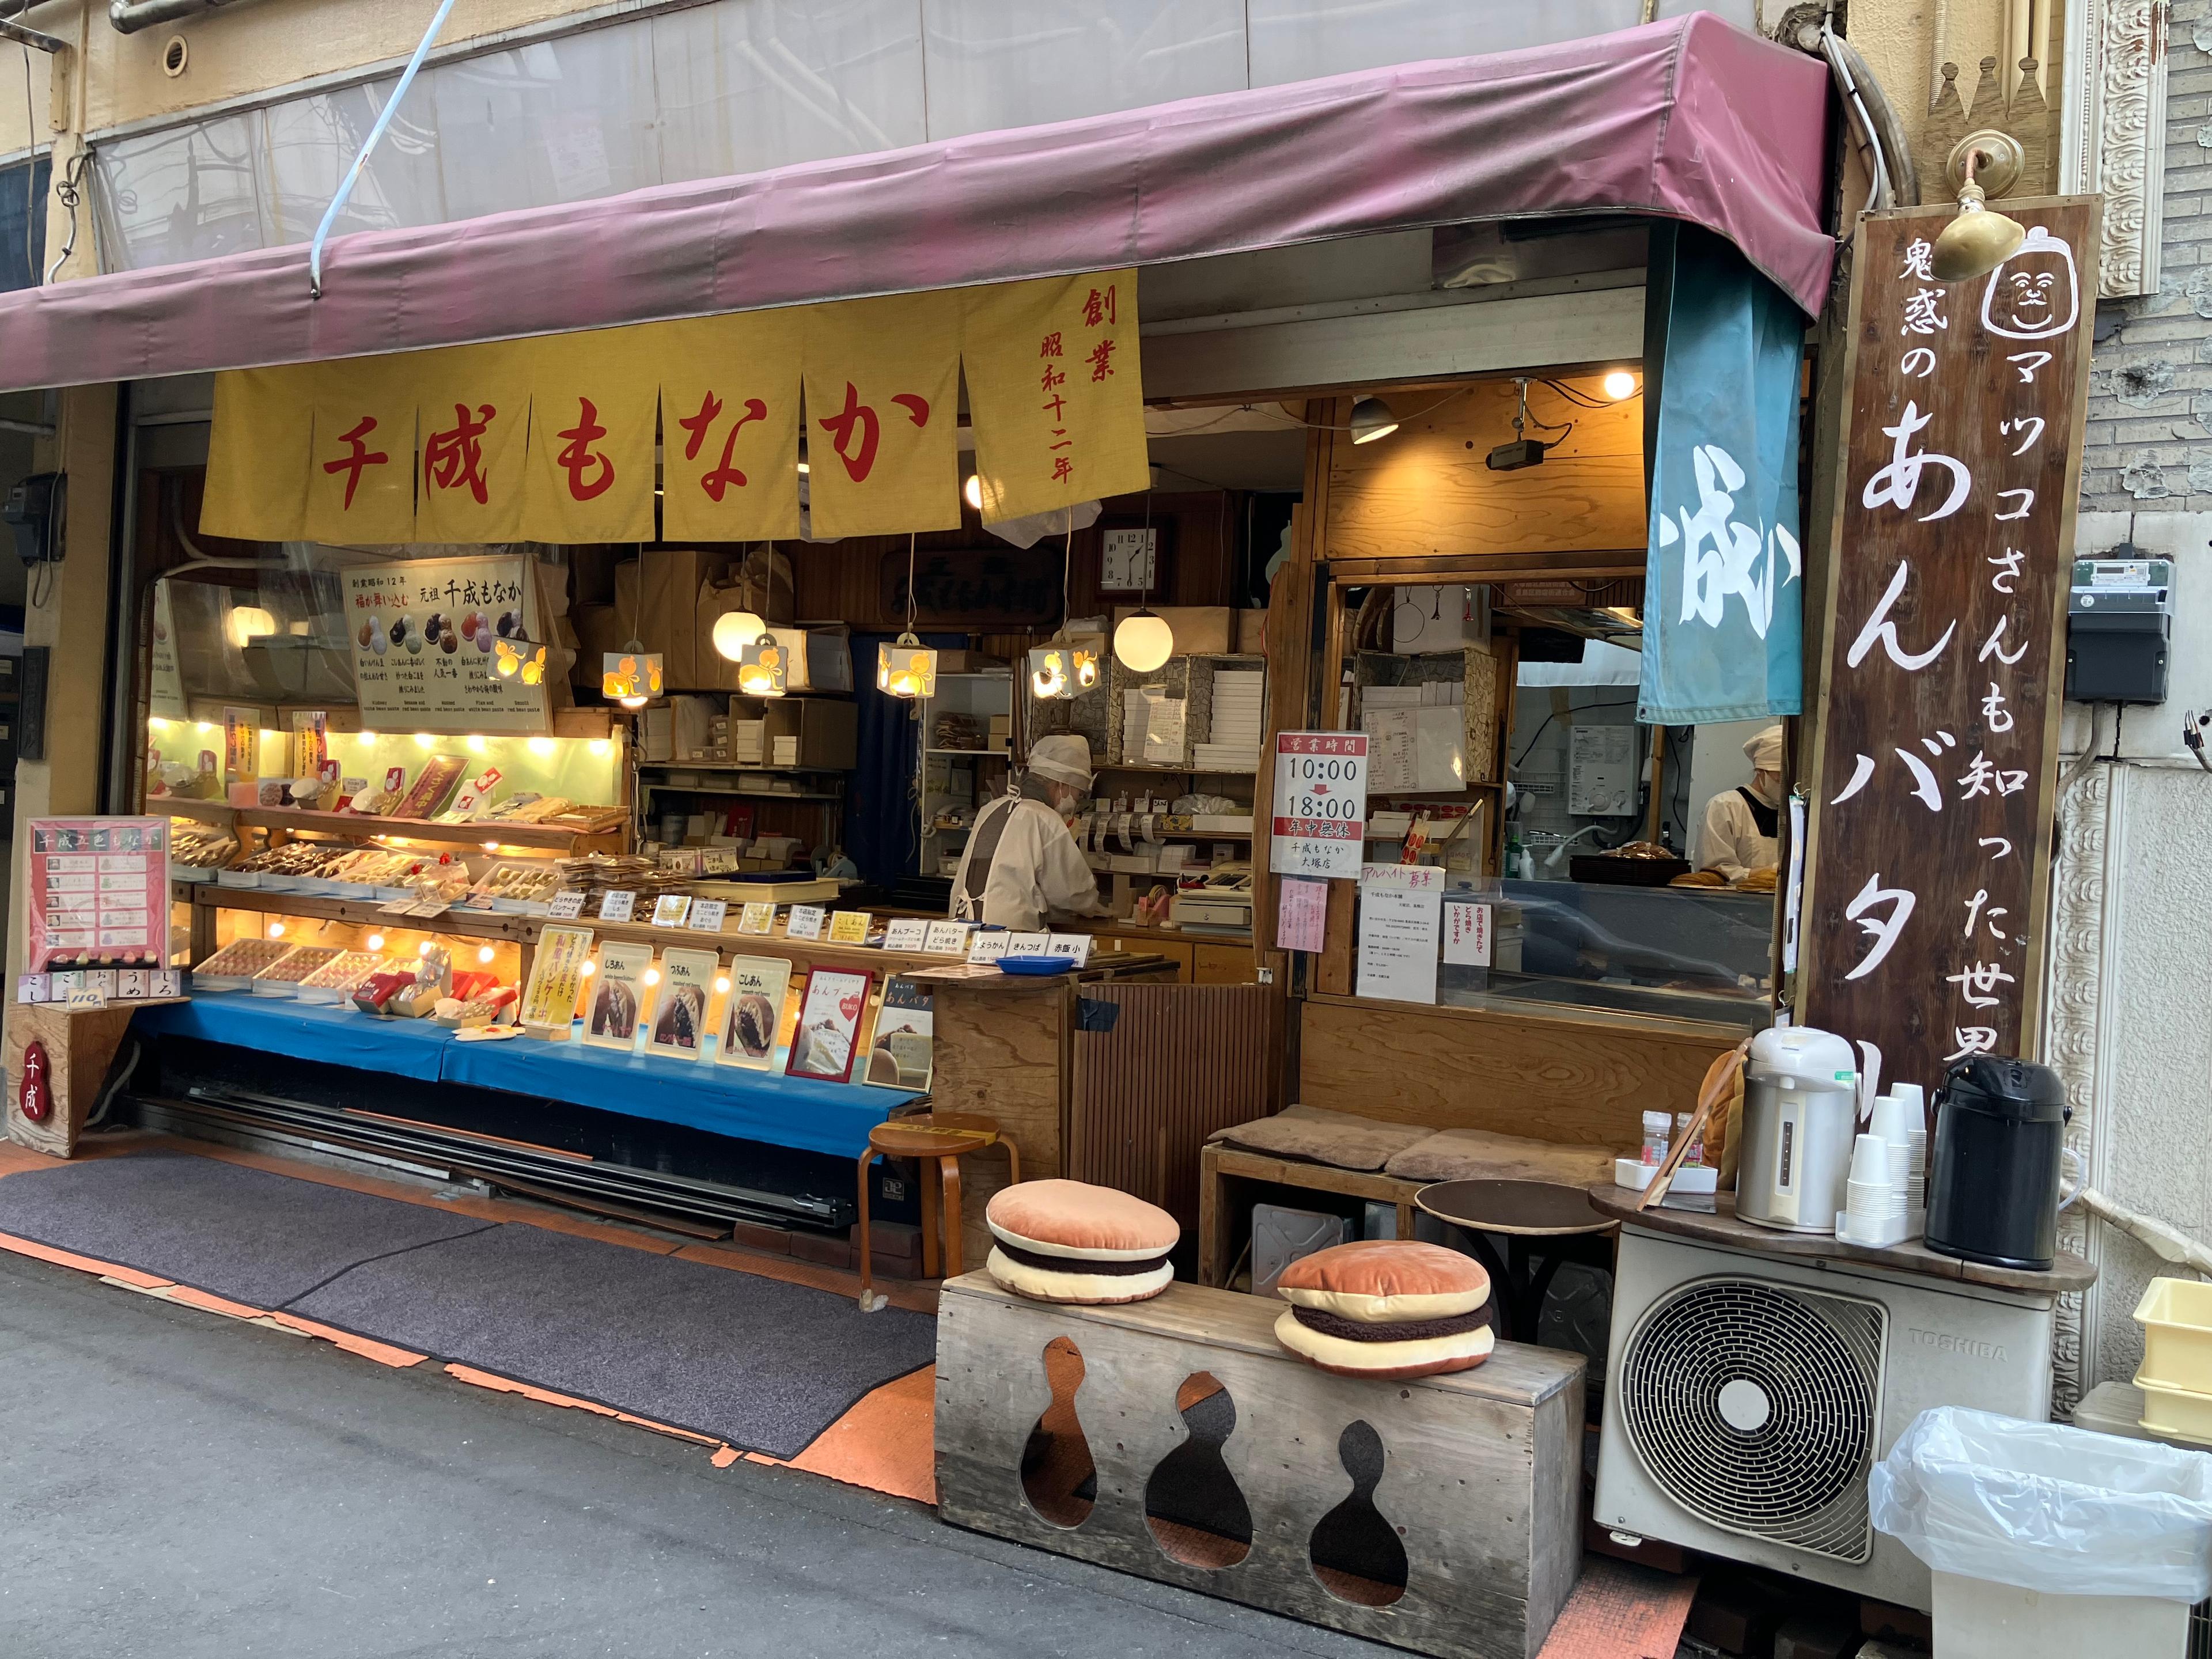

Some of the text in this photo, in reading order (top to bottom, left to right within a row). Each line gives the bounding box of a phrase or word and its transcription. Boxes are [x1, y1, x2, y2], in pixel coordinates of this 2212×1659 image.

[1082, 285, 1116, 382] 創業
[1040, 331, 1074, 485] 昭和十二年
[323, 380, 930, 511] 千成もなか
[355, 592, 409, 608] 福が舞い込む
[420, 578, 521, 608] 元祖 千成もなか
[461, 657, 490, 666] 白あんに紀州
[1290, 737, 1355, 753] 営業時間
[1290, 757, 1357, 781] 10:00
[1289, 796, 1355, 819] 18:00
[1289, 819, 1350, 839] 年中無休
[39, 835, 158, 849] 千成五色もなか
[1291, 842, 1344, 854] 千成もなか
[1301, 858, 1332, 869] 大塚店
[891, 927, 922, 935] あんブーコ
[933, 926, 964, 935] あんバター
[1476, 907, 1484, 953] お店で焼きたて
[933, 937, 957, 945] どら焼き
[1013, 943, 1041, 952] きんつば
[1054, 944, 1080, 953] 赤飯 小
[605, 959, 625, 971] しろあん
[671, 965, 691, 977] つぶあん
[126, 971, 141, 996] うめ
[159, 971, 172, 995] しろ
[738, 974, 762, 987] こしあん
[29, 976, 38, 1001] こし
[812, 984, 860, 998] あんブーコ
[885, 991, 929, 1006] あんバタ
[841, 1002, 858, 1011] BUKO
[25, 1052, 40, 1115] 千成
[1908, 1328, 2009, 1363] TOSHIBA
